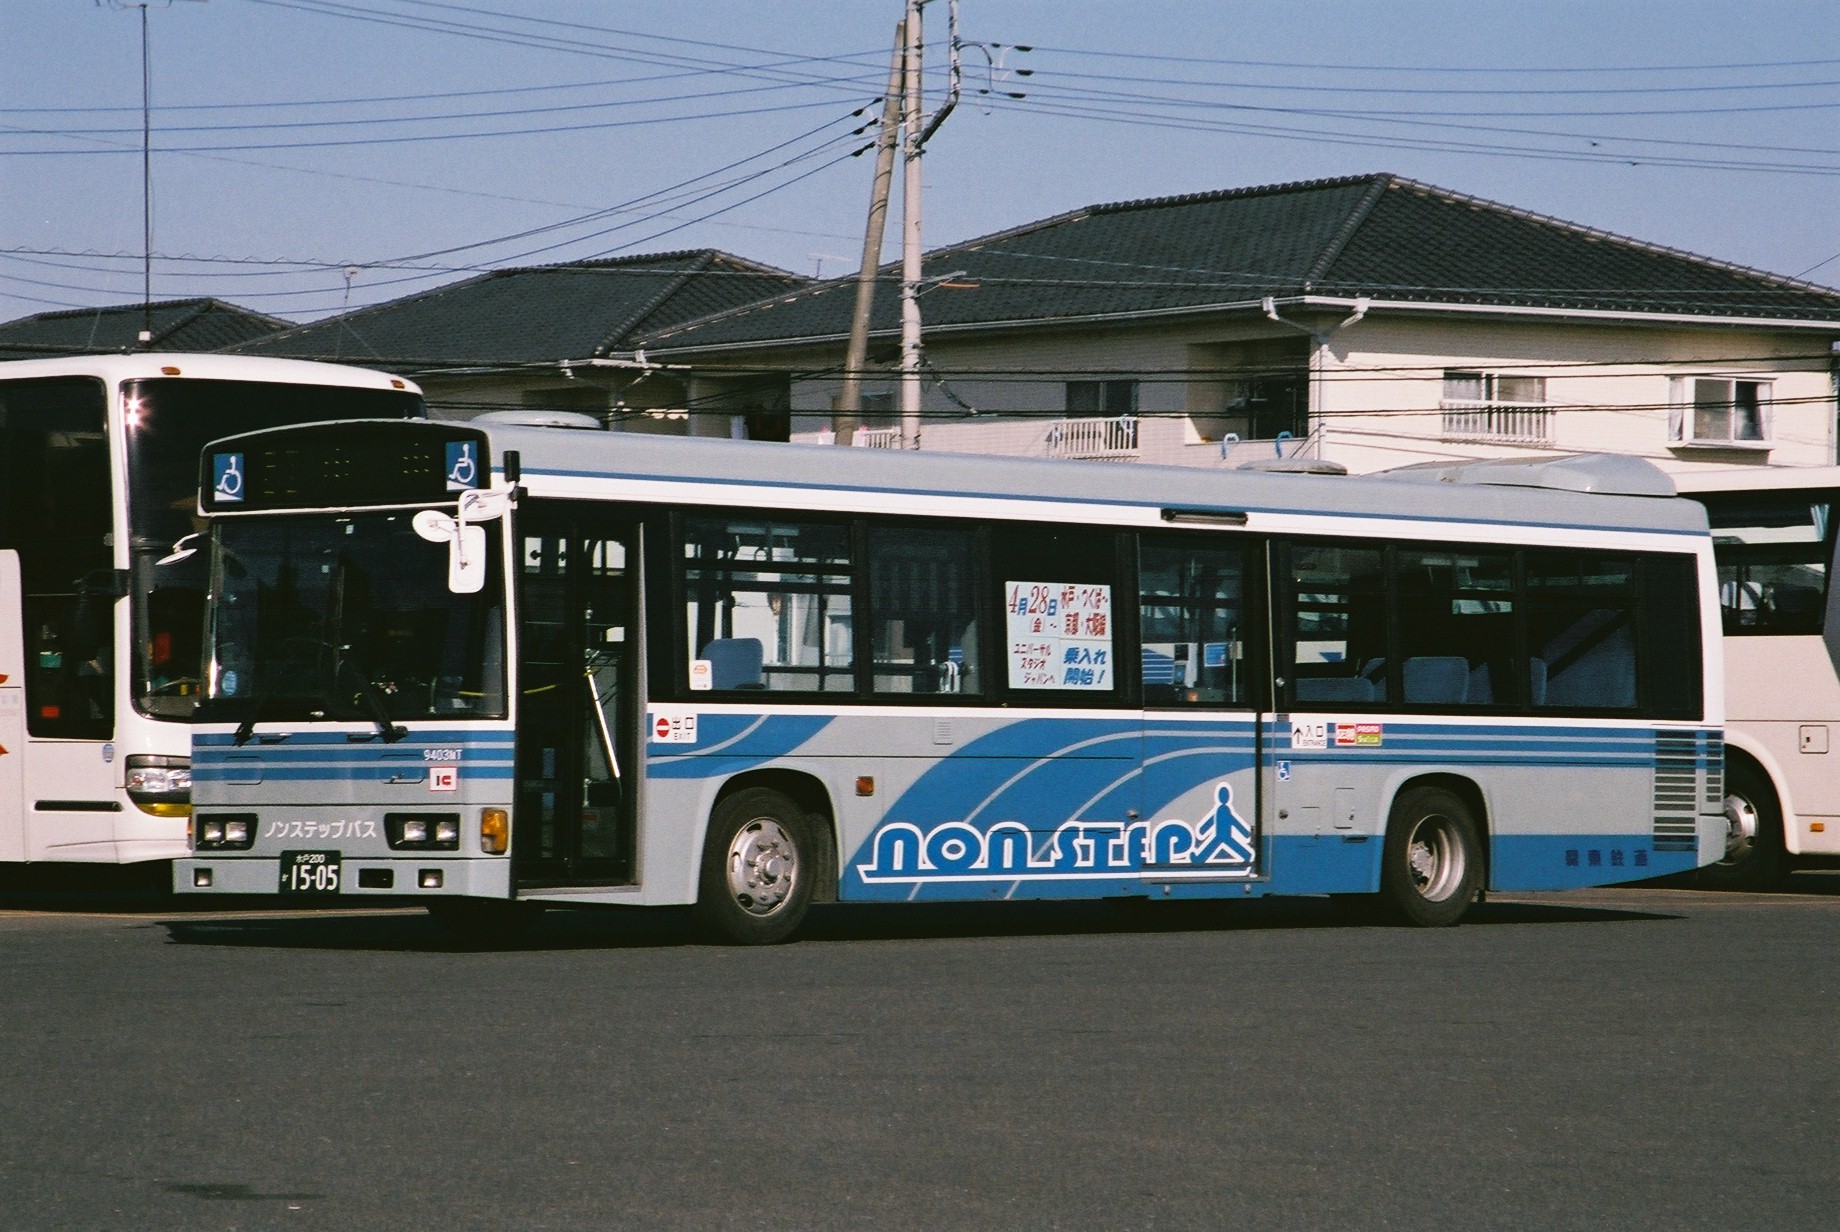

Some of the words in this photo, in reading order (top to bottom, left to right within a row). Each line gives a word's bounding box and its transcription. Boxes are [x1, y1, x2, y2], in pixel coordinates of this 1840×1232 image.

[1009, 585, 1057, 616] 4月28日
[1063, 647, 1107, 664] 乗入れ
[672, 716, 694, 730] 出口
[1305, 724, 1324, 738] 入口
[264, 820, 377, 838] ノンステップバス
[291, 864, 339, 890] 15-05
